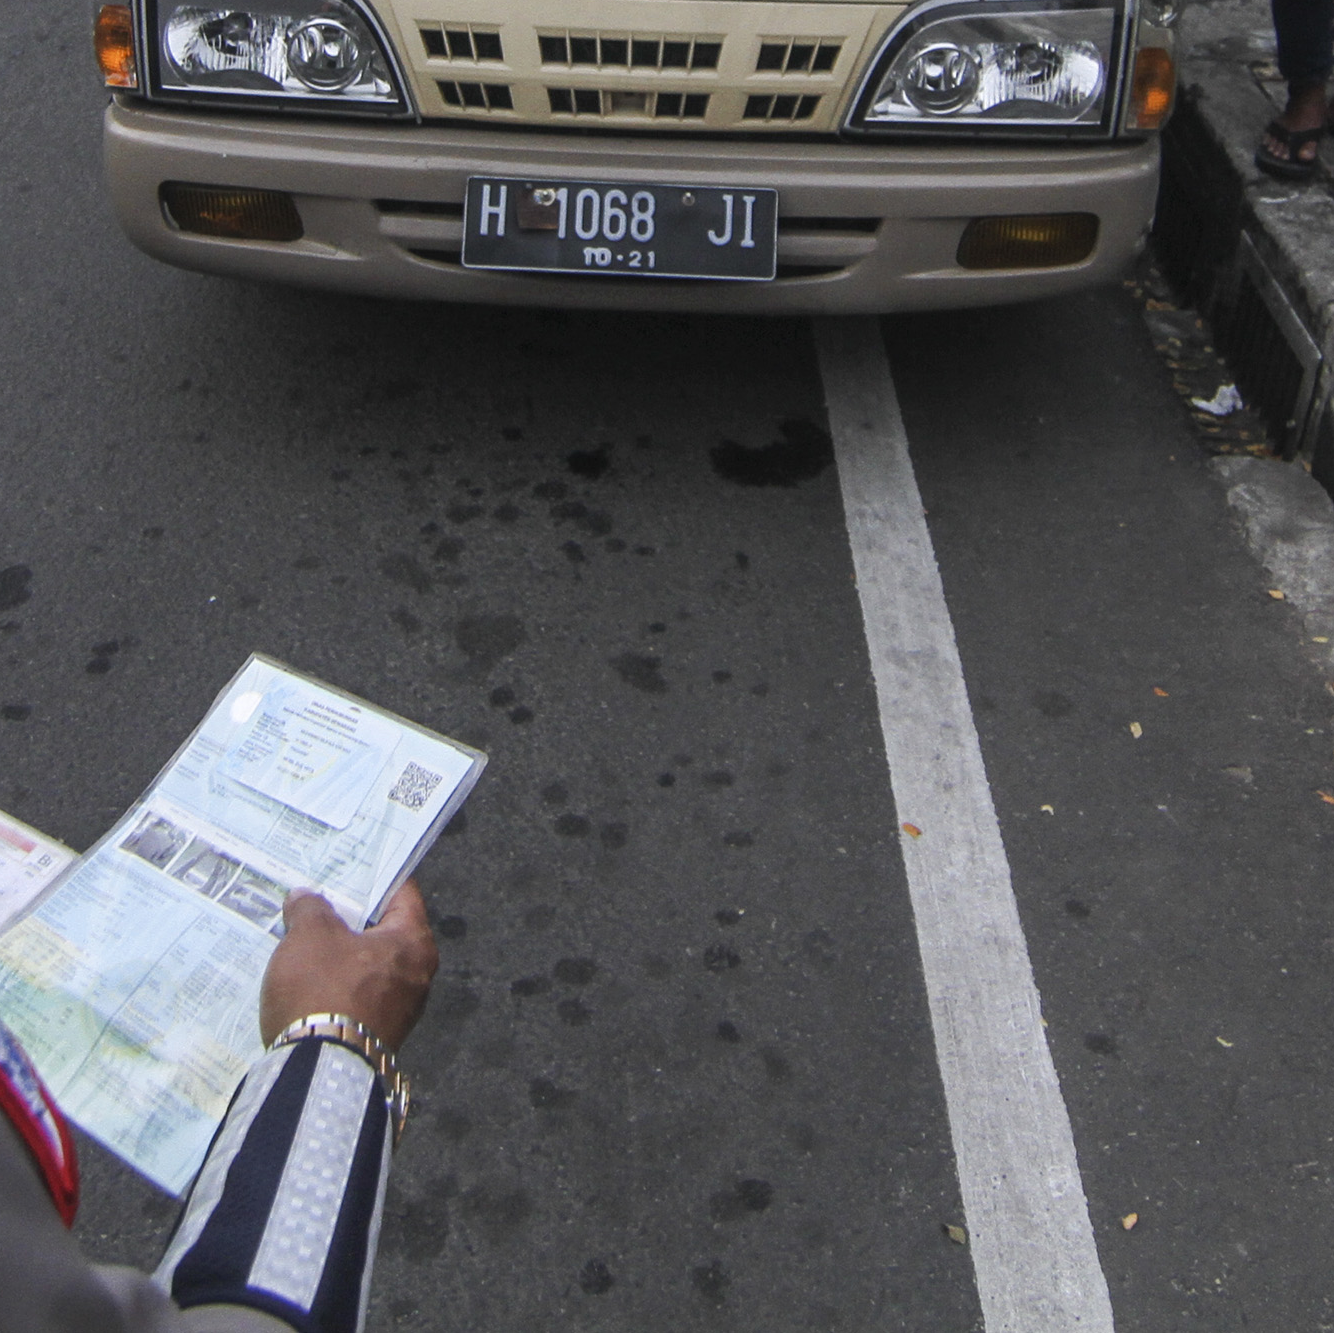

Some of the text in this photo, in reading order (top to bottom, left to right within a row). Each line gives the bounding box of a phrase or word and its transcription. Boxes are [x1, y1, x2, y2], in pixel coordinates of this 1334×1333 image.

[479, 184, 756, 249] H 1068 JI
